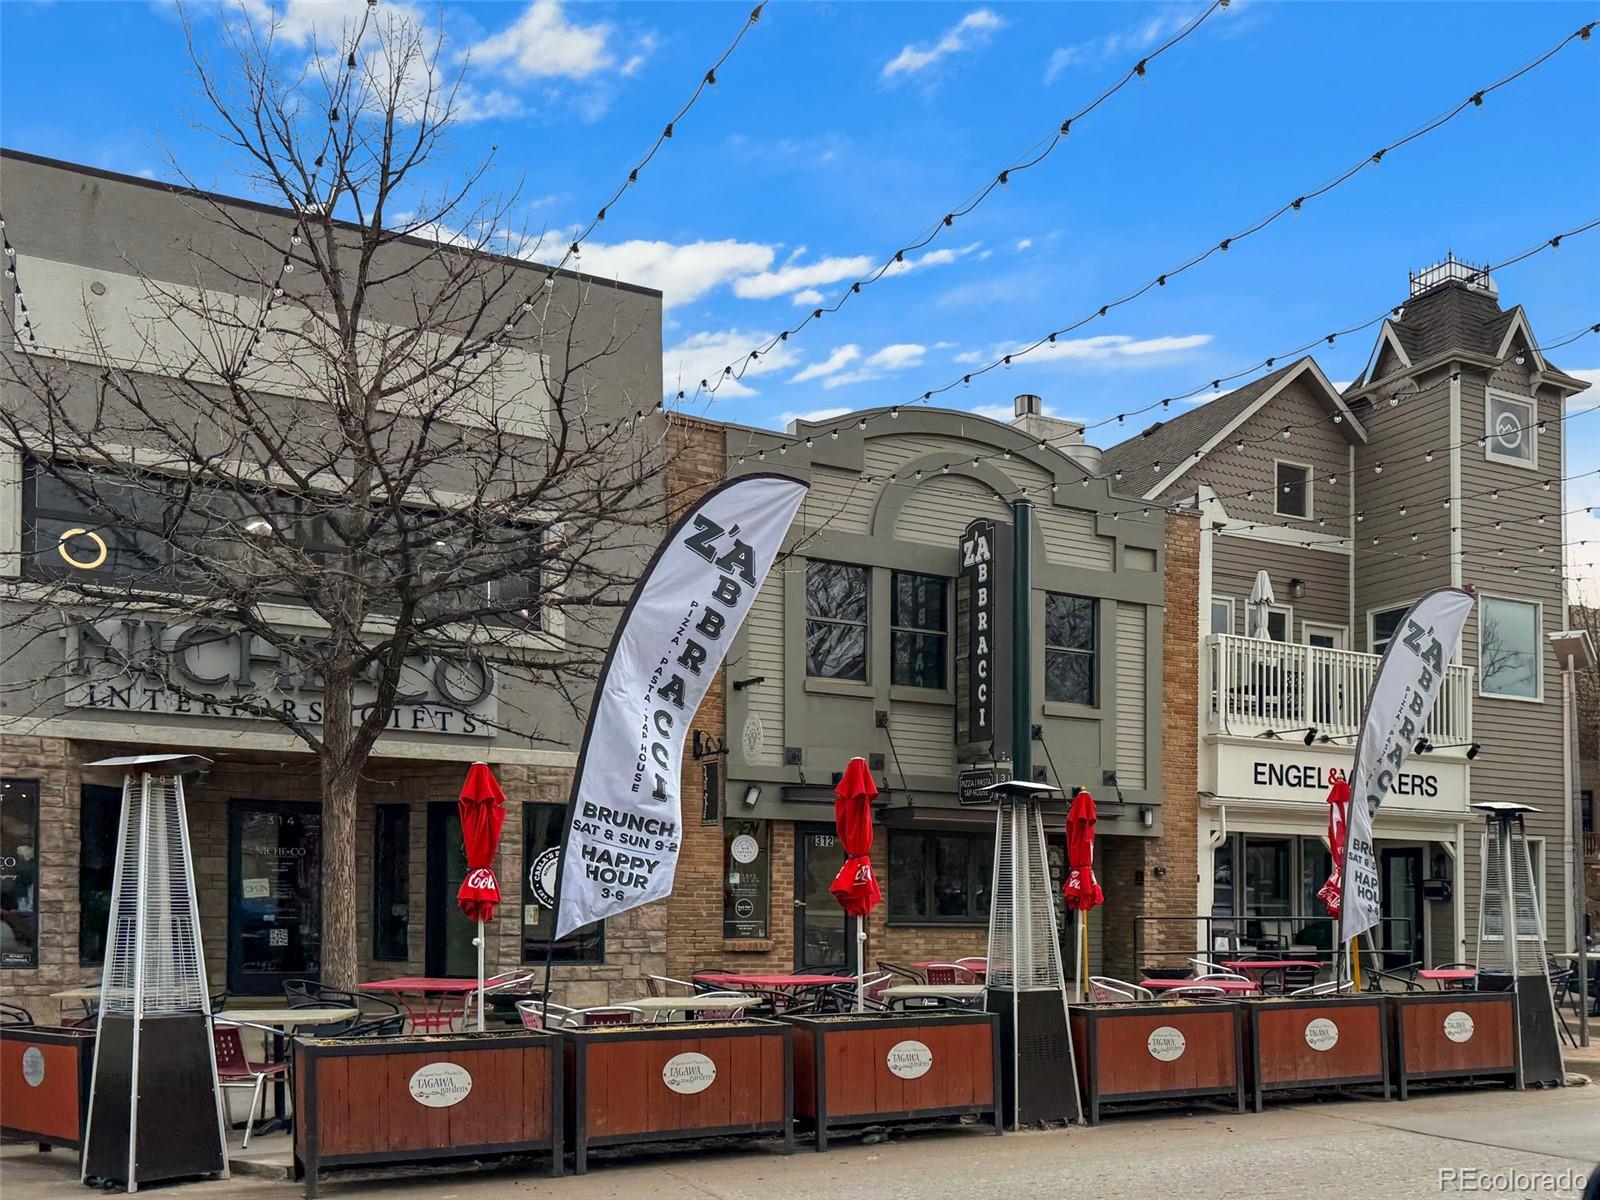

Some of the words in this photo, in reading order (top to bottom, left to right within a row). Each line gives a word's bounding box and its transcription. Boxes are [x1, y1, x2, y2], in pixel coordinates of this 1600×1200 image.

[671, 600, 698, 646] PIZZA
[962, 531, 991, 727] Z'ABBRACCI
[644, 657, 669, 703] PASTA
[631, 743, 647, 792] HOUSE
[582, 801, 675, 838] BRUNCH
[573, 819, 600, 836] SAT
[603, 829, 614, 841] &
[619, 833, 651, 849] SUN
[815, 835, 834, 847] 312
[1352, 838, 1374, 858] BRU
[534, 852, 554, 881] CARLA'S
[581, 843, 661, 875] HAPPY
[1348, 851, 1362, 865] SAT
[585, 863, 649, 890] HOUR
[1355, 870, 1378, 889] HAP
[1357, 886, 1379, 905] HOU
[416, 1077, 454, 1089] TAGAWA
[669, 1065, 701, 1077] TAGAWA
